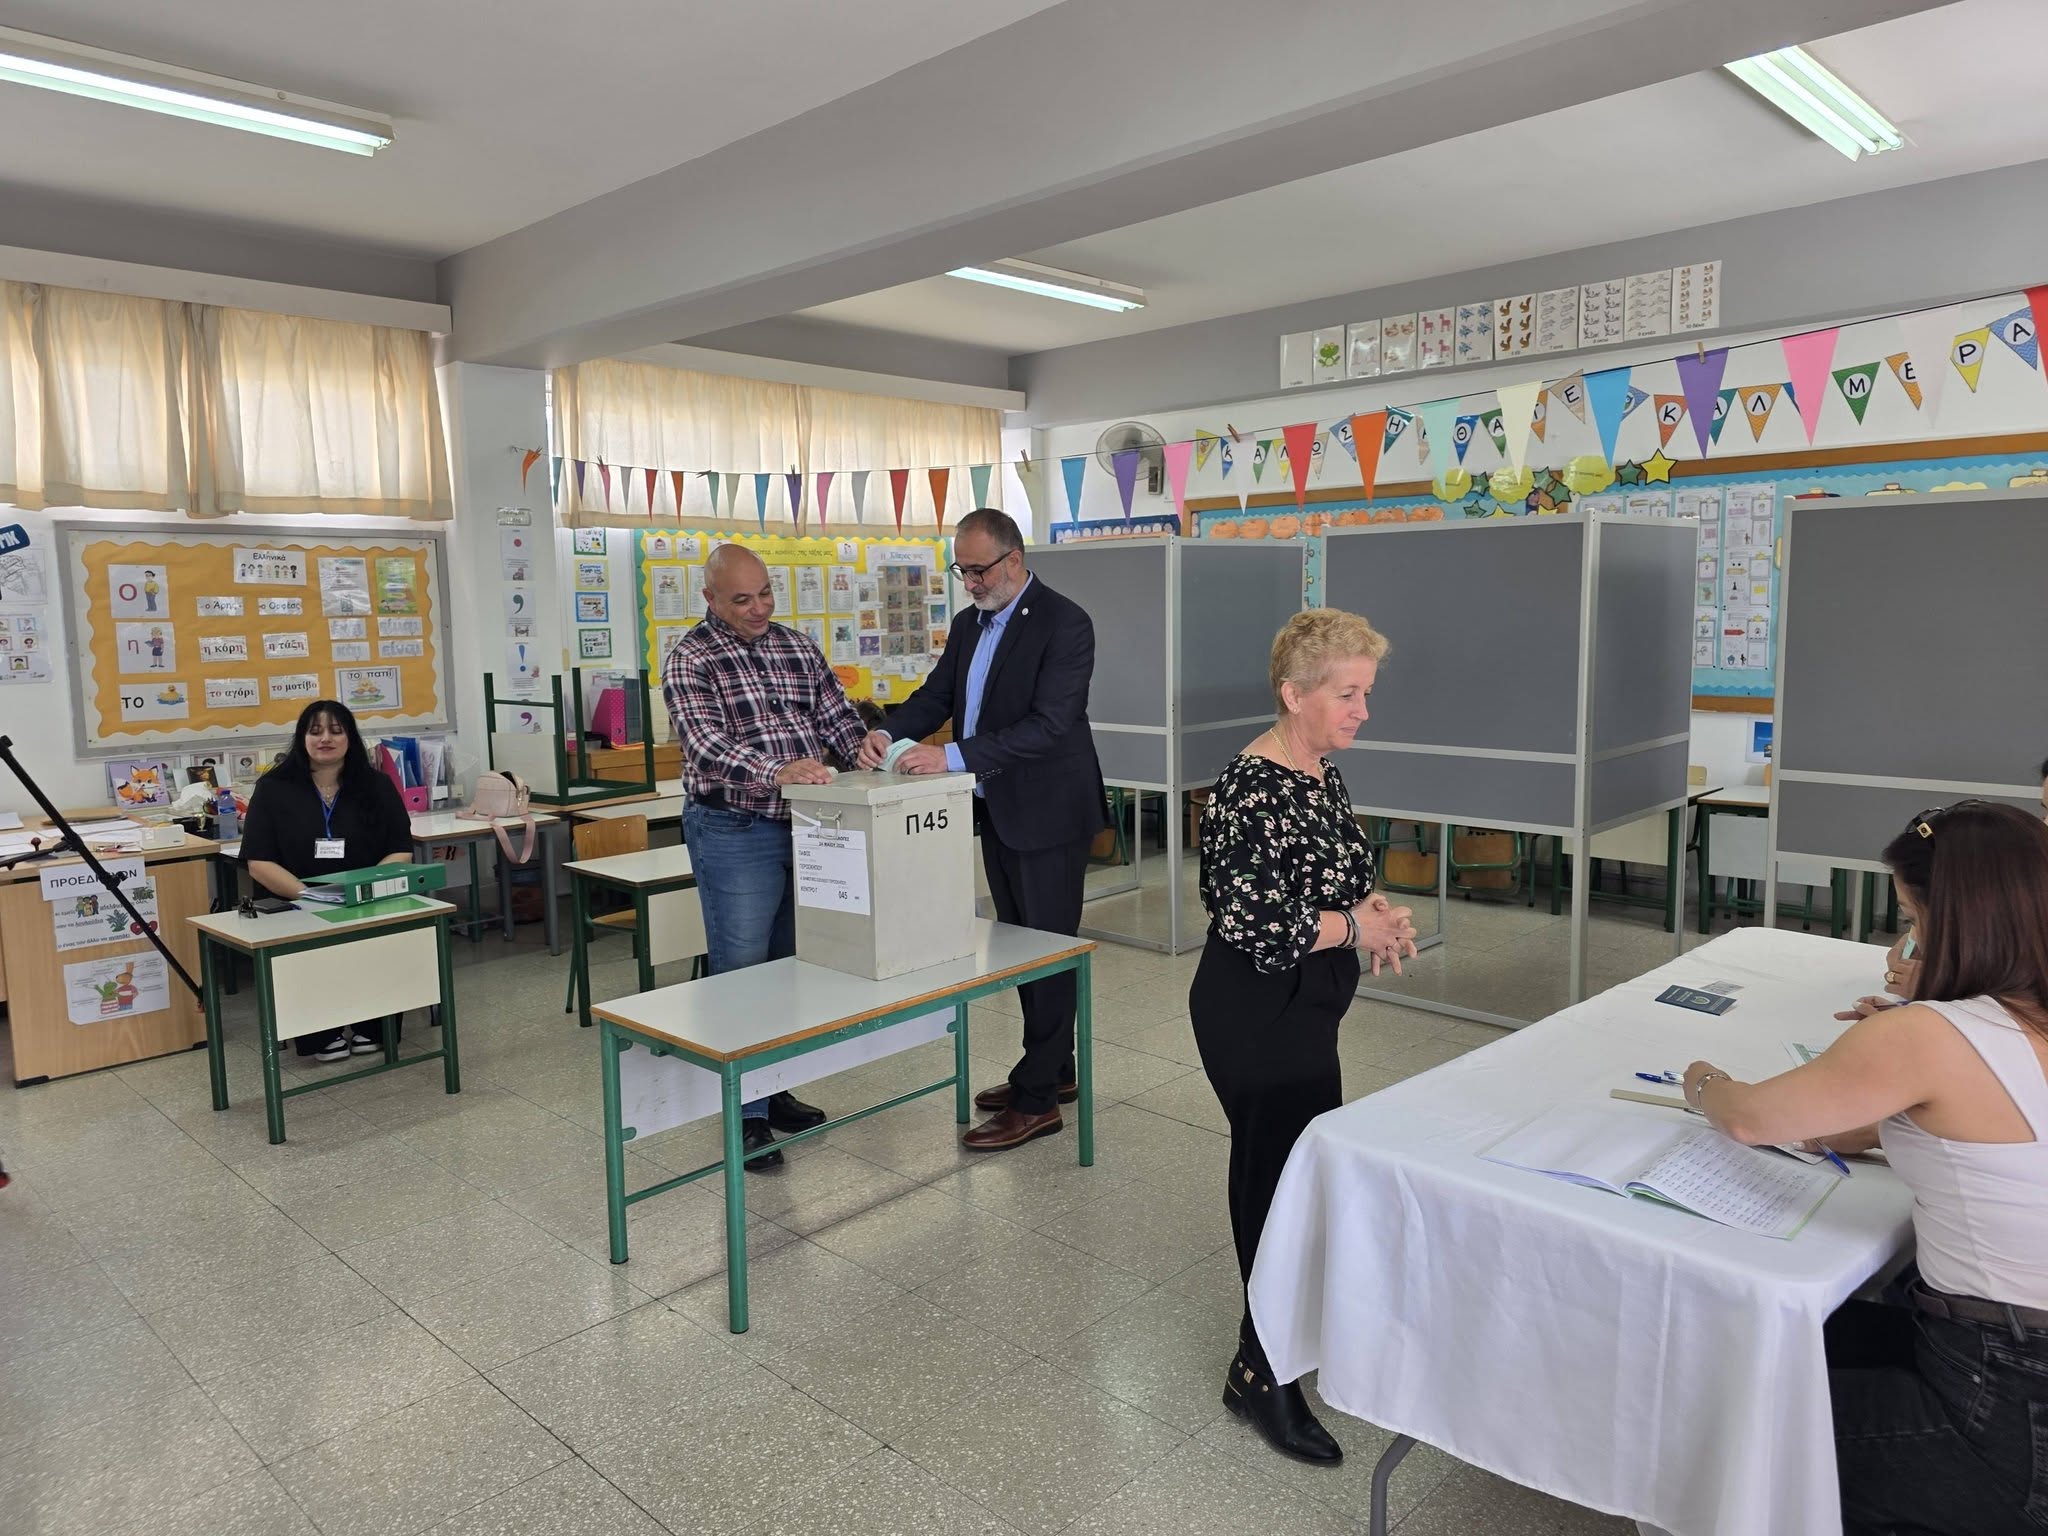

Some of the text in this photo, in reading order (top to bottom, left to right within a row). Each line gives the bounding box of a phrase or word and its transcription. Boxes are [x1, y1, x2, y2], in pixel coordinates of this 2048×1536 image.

[128, 639, 139, 654] η
[203, 642, 243, 655] η κόρη
[268, 639, 305, 651] η τάξη
[285, 680, 317, 692] μοτίβο
[225, 687, 255, 699] αγόρι
